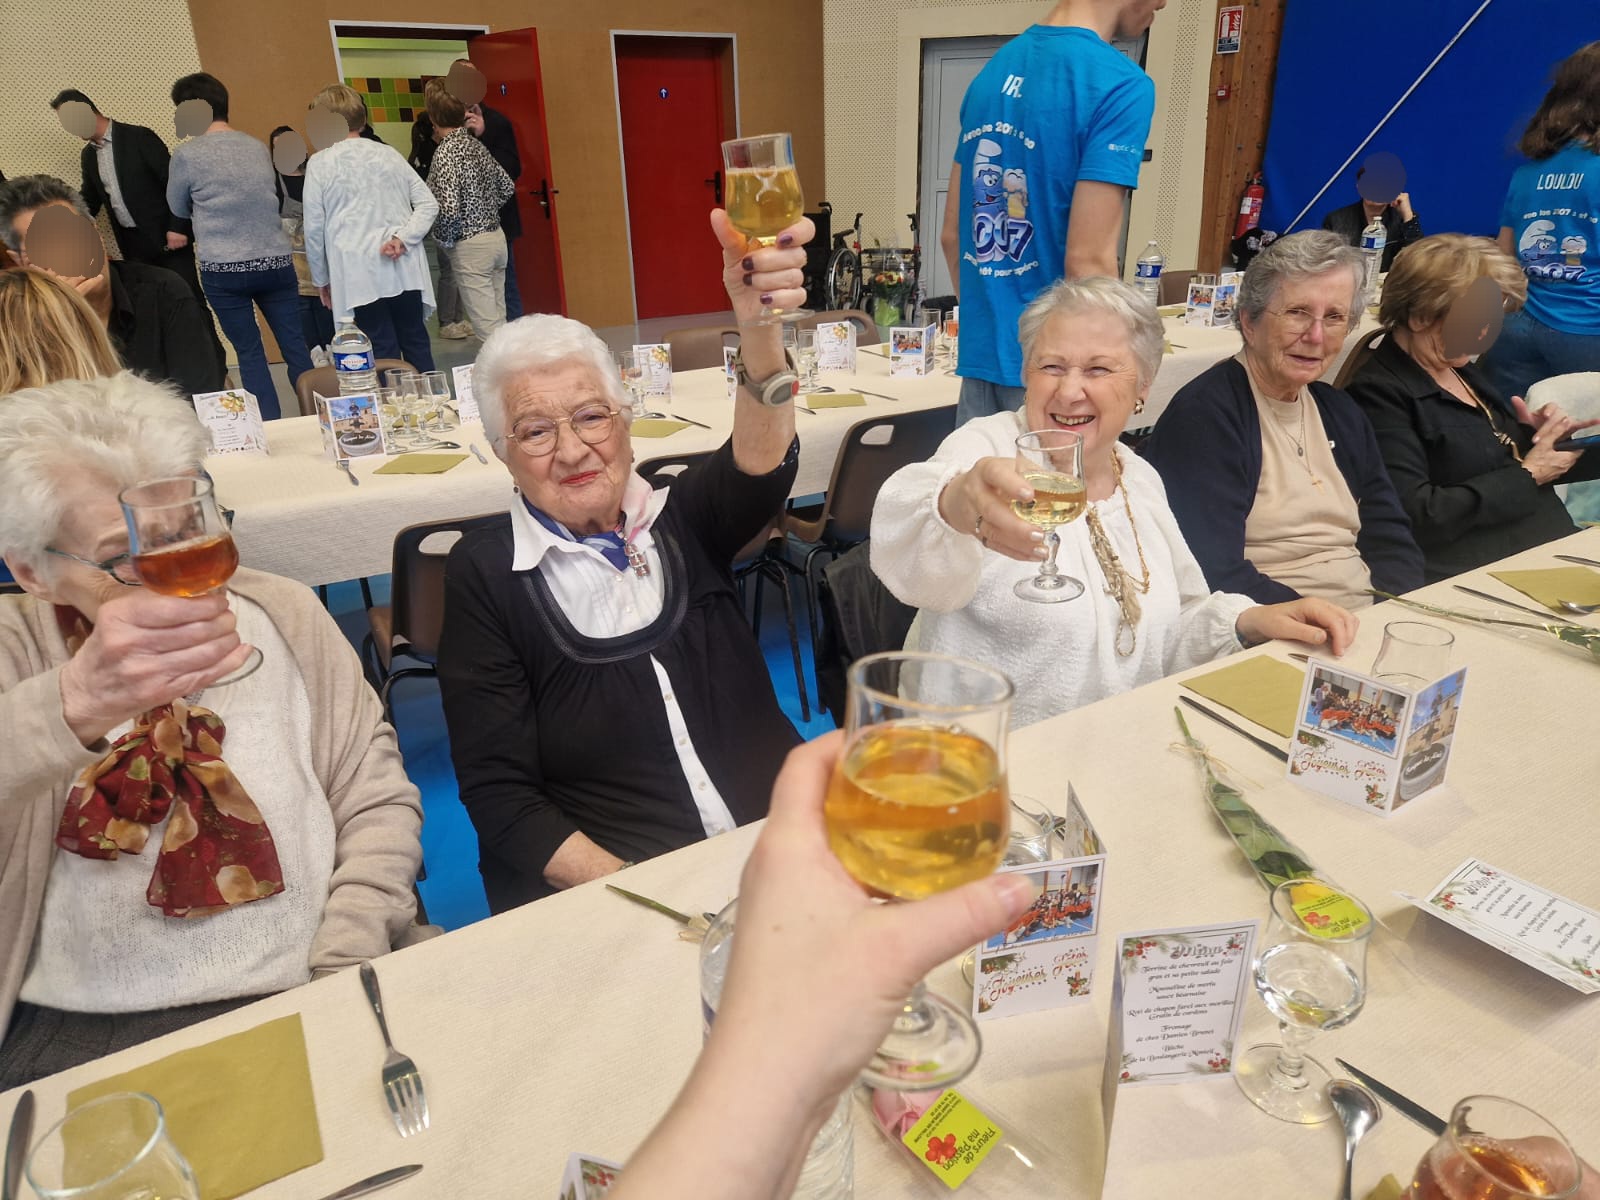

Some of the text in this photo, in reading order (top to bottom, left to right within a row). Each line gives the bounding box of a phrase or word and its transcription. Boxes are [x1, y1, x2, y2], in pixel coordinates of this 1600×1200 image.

[1536, 173, 1584, 190] LOULOU
[973, 211, 1033, 262] 007
[962, 1127, 996, 1164] Fleurs de
[968, 1128, 980, 1142] ma
